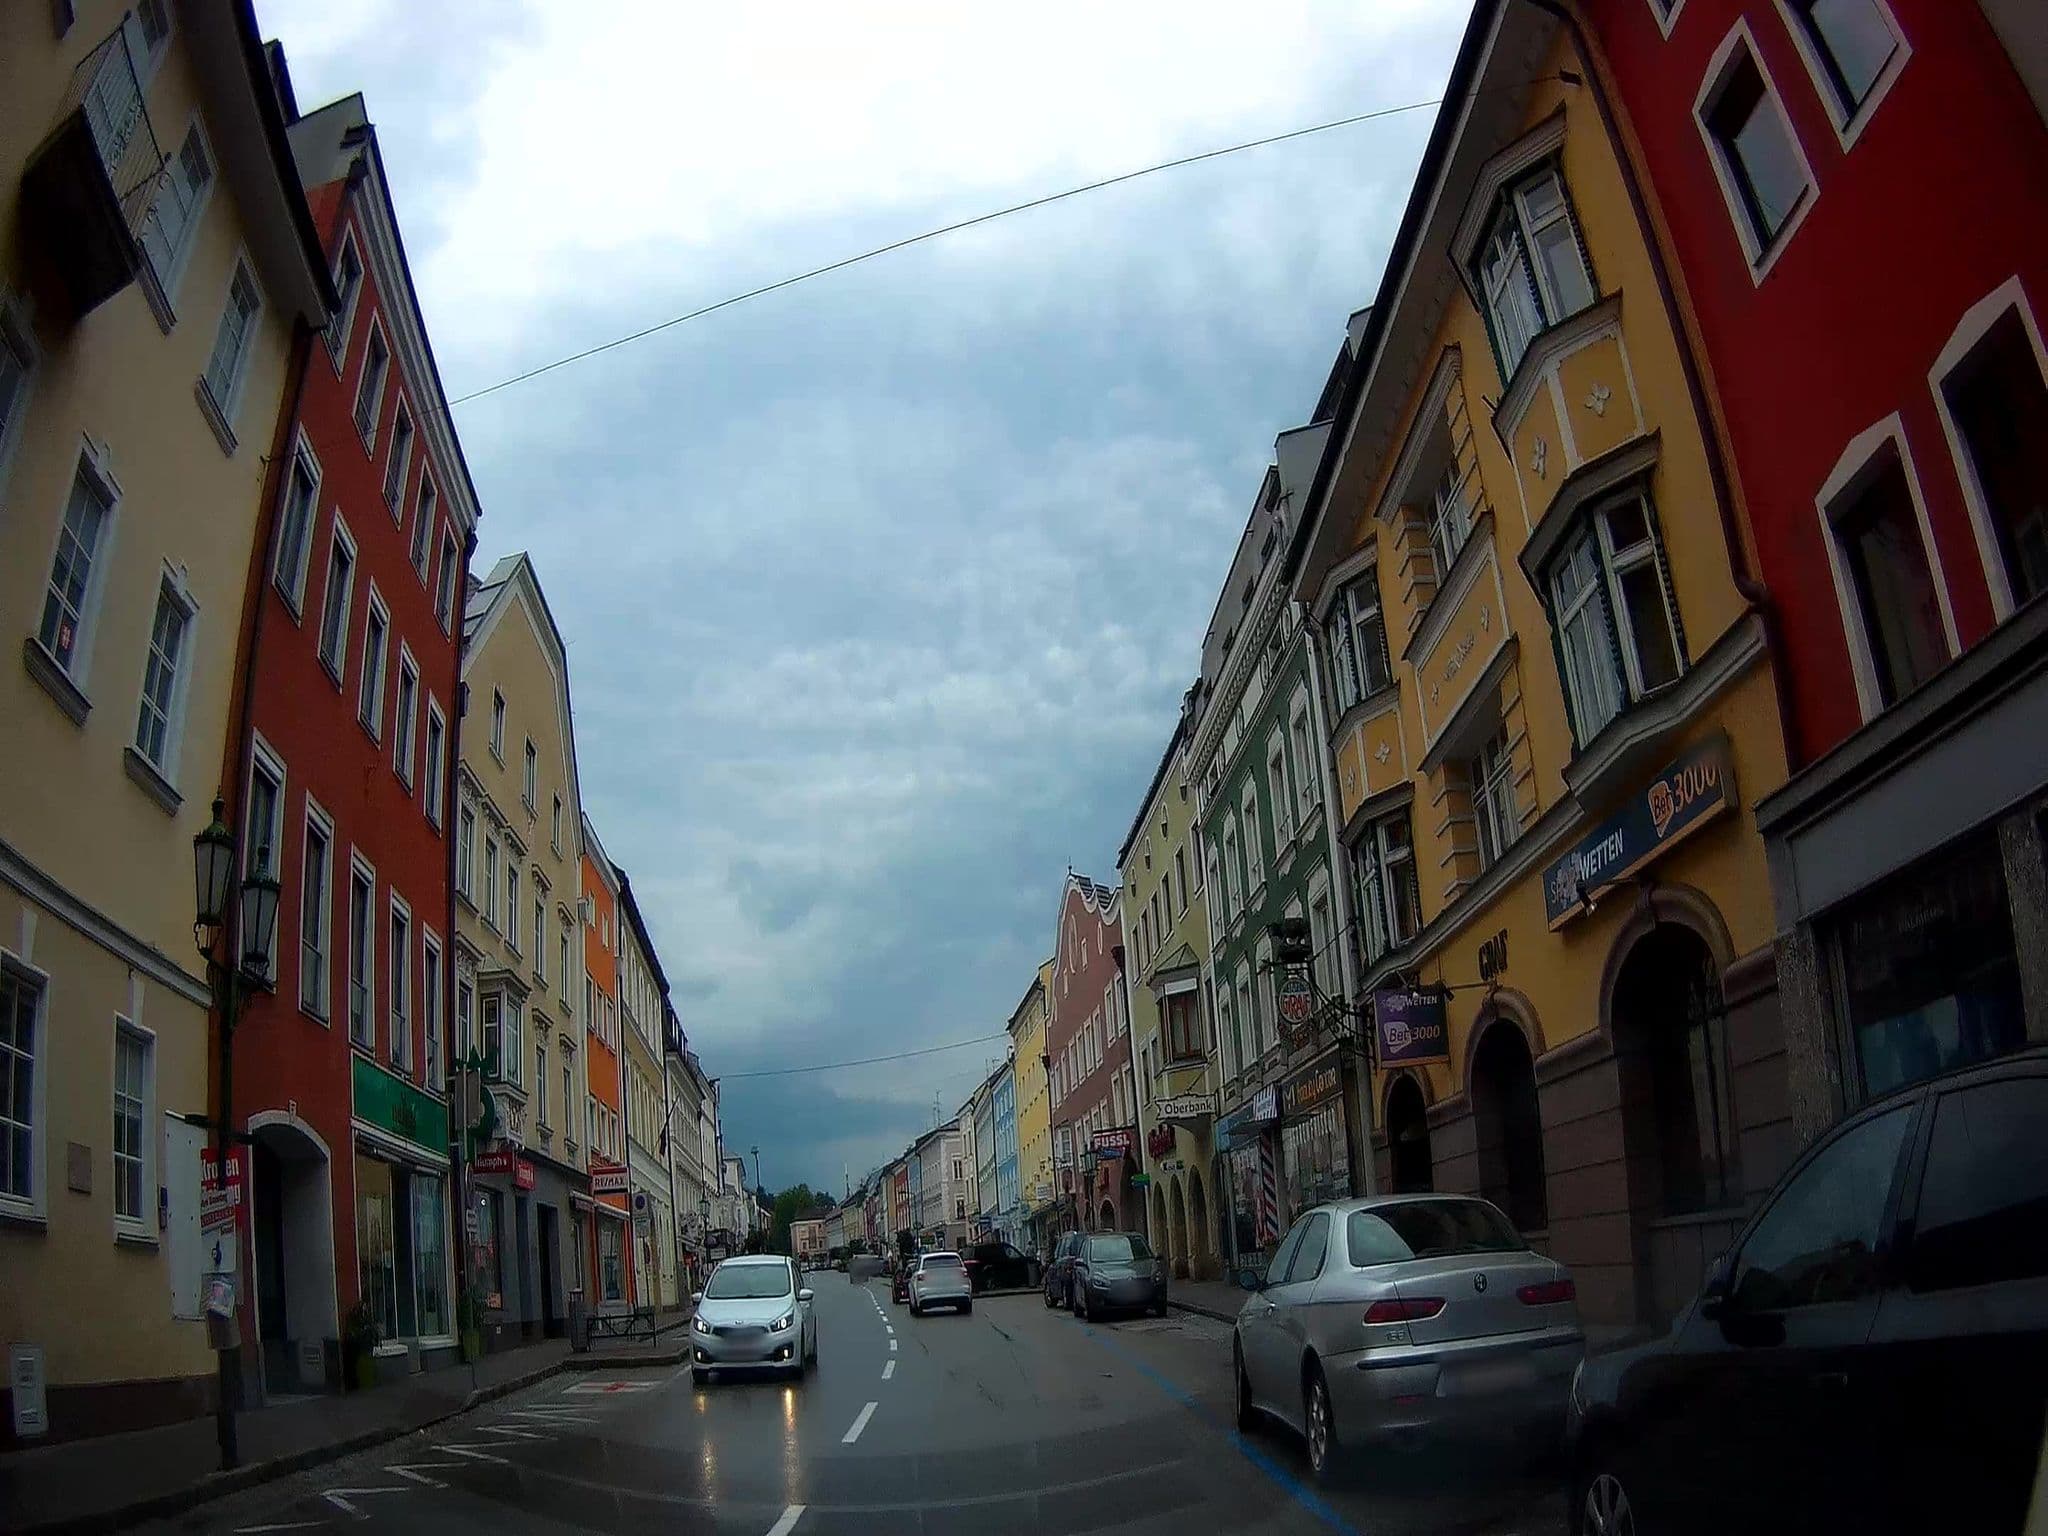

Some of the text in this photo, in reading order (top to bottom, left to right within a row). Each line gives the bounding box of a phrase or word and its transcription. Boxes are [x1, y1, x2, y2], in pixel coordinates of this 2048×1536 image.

[1674, 763, 1716, 814] 3000
[1389, 1024, 1440, 1042] Bet 3000
[1164, 1099, 1212, 1115] Oberbank
[201, 1158, 240, 1181] Kroen
